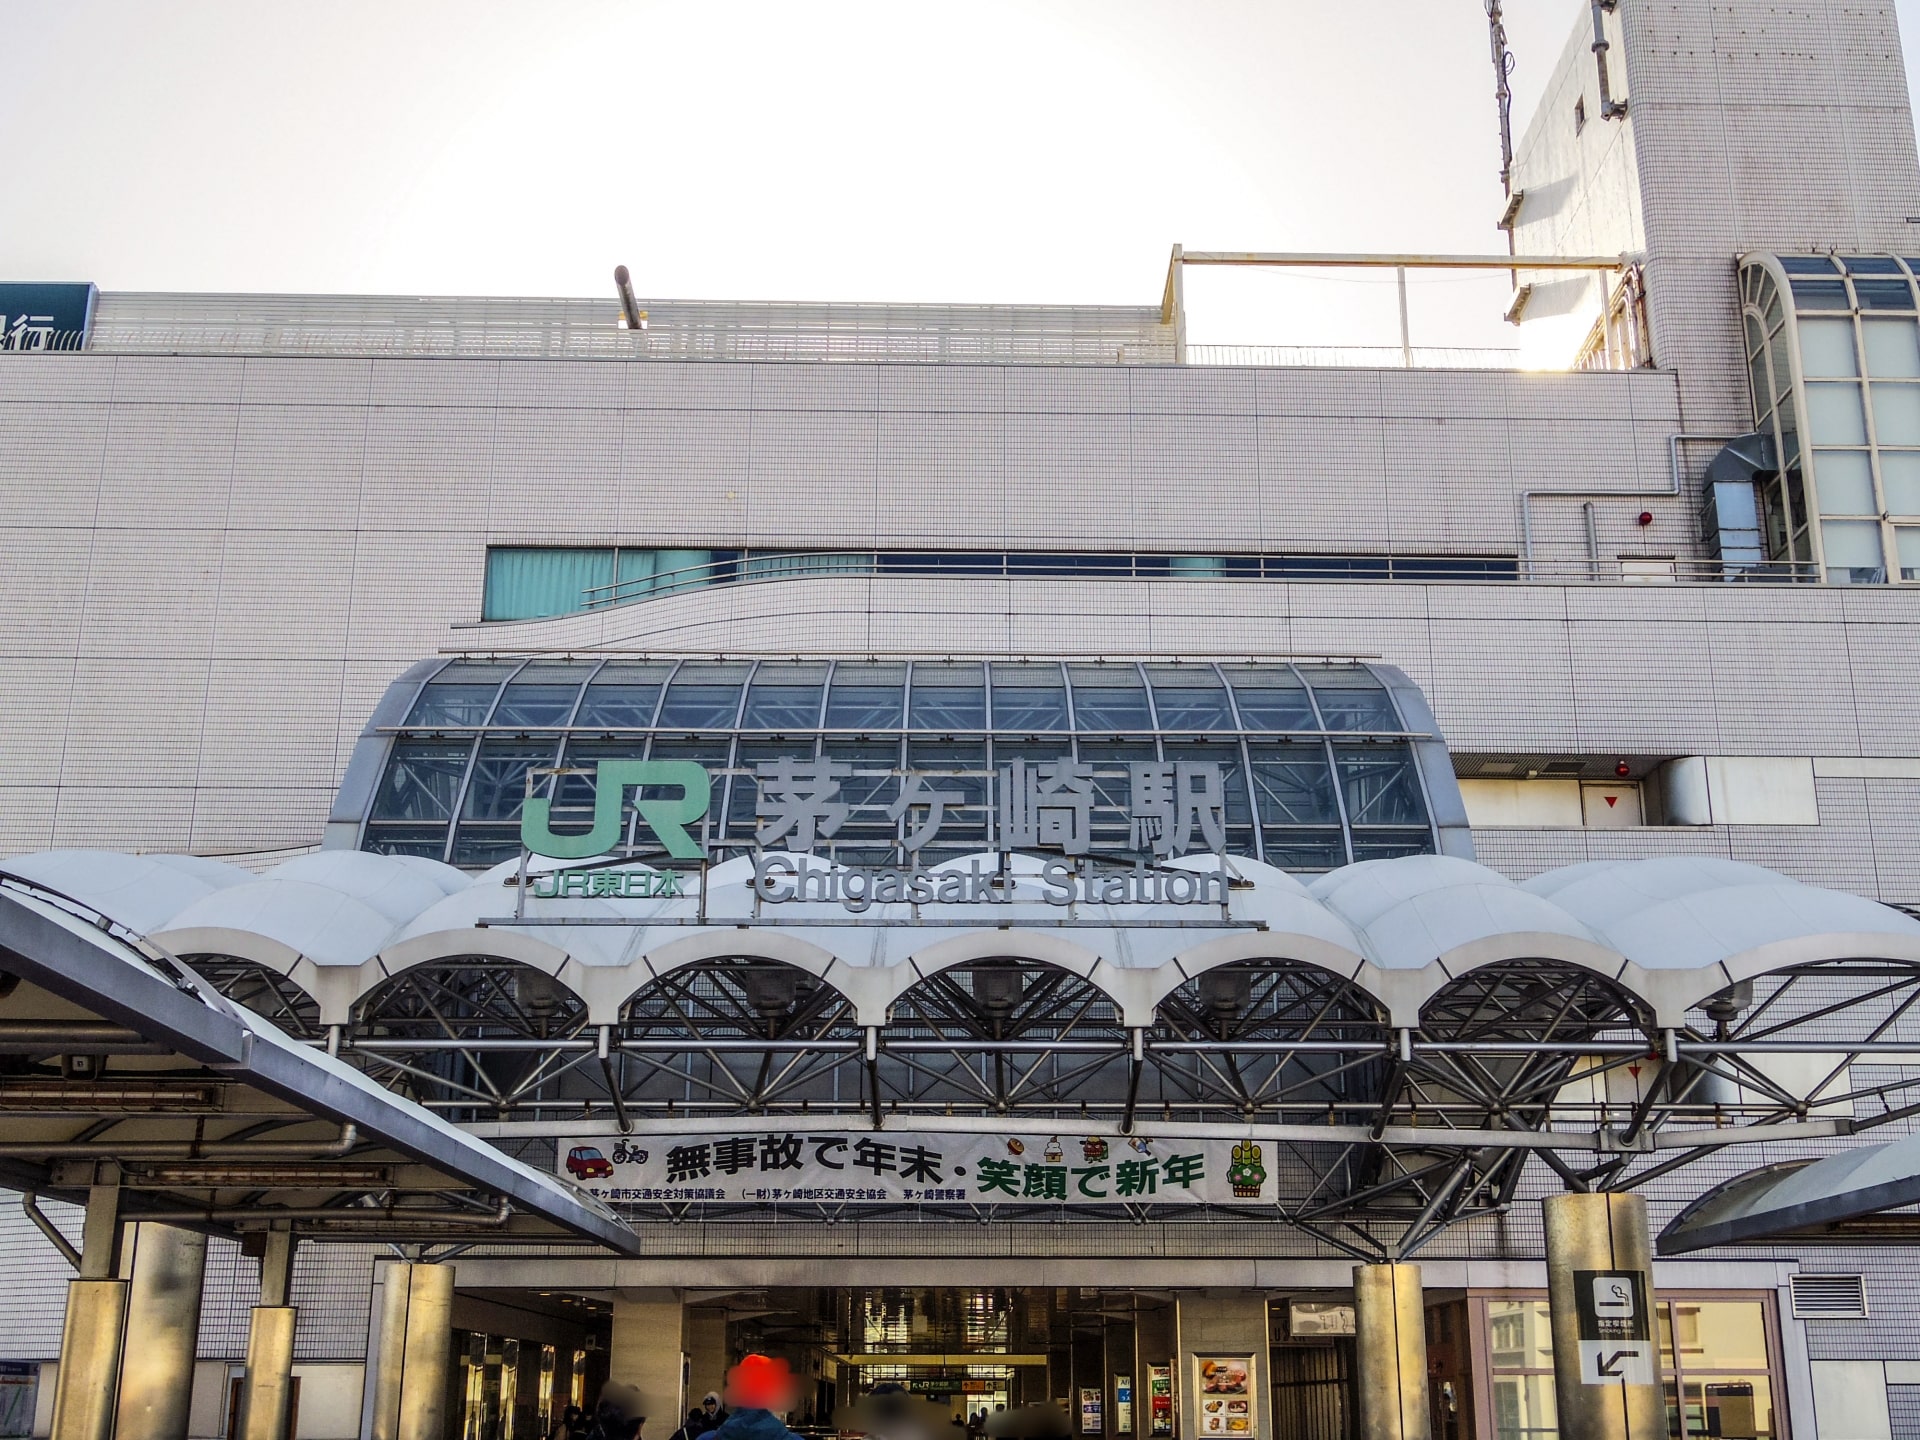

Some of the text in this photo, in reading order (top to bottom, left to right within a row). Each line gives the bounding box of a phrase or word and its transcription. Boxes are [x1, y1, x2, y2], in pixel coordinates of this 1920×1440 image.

[0, 314, 54, 350] 行
[521, 760, 711, 859] JR
[754, 755, 1226, 855] 茅ヶ崎駅
[533, 869, 685, 898] JR東日本
[755, 855, 1229, 913] Chigasaki Station
